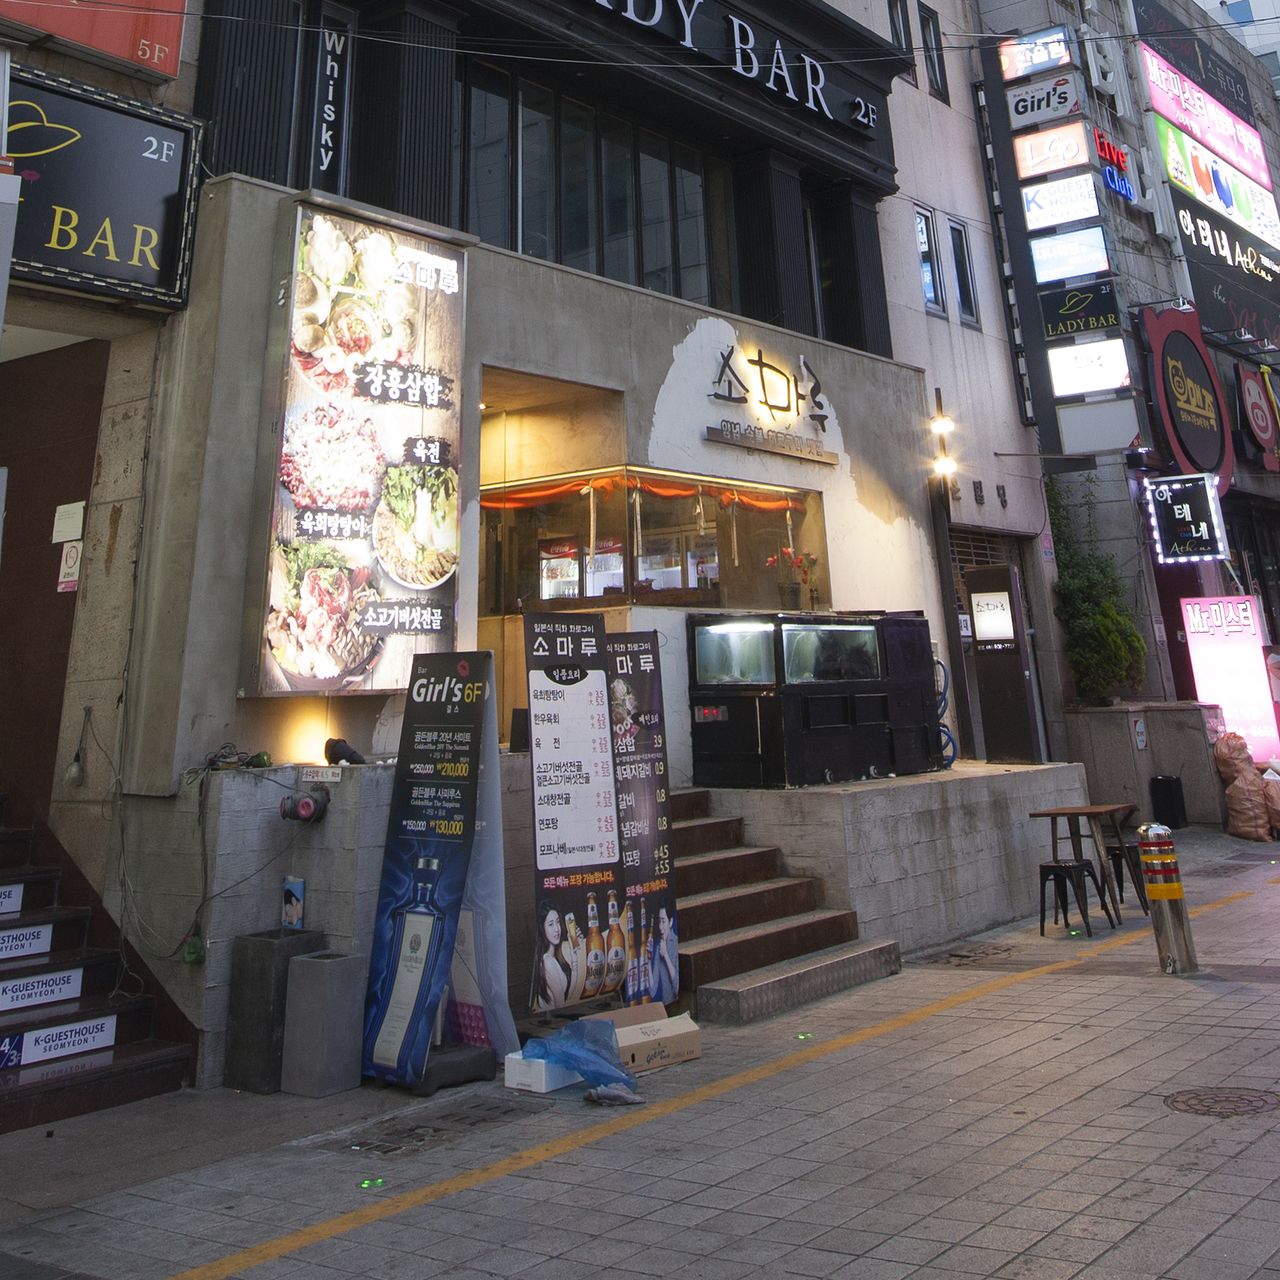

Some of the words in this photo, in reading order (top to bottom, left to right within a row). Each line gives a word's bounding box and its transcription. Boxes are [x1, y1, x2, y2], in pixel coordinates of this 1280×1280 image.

[137, 38, 170, 65] 5F
[728, 13, 835, 120] BAR
[319, 30, 346, 172] Whisky
[1014, 86, 1069, 116] Girl's
[1093, 127, 1129, 171] Live
[1104, 164, 1136, 202] Club
[45, 204, 161, 271] BAR
[141, 136, 175, 164] 2F
[1179, 208, 1234, 266] 아테네
[1048, 317, 1086, 337] LADY
[1089, 314, 1118, 329] BAR
[363, 367, 443, 407] 장흥삼합
[412, 440, 441, 464] 육전
[1156, 487, 1210, 541] 아테네
[363, 608, 443, 632] 소고기버섯전골
[554, 624, 568, 634] 직화
[569, 623, 595, 633] 화로구이
[1186, 600, 1257, 636] Mr.미스터
[533, 636, 598, 657] 소마루
[417, 666, 428, 674] Bar
[411, 676, 464, 703] Girl's
[464, 682, 483, 704] 6F
[536, 761, 583, 774] 소고기버섯전골
[543, 877, 556, 889] 모든
[556, 875, 569, 887] 메뉴
[569, 873, 583, 886] 포장
[1, 975, 73, 996] K-GUESTHOUSE
[10, 988, 56, 1002] SEOMYEON
[34, 1022, 106, 1047] K-GUESTHOUSE
[42, 1039, 88, 1053] SEOMYEON
